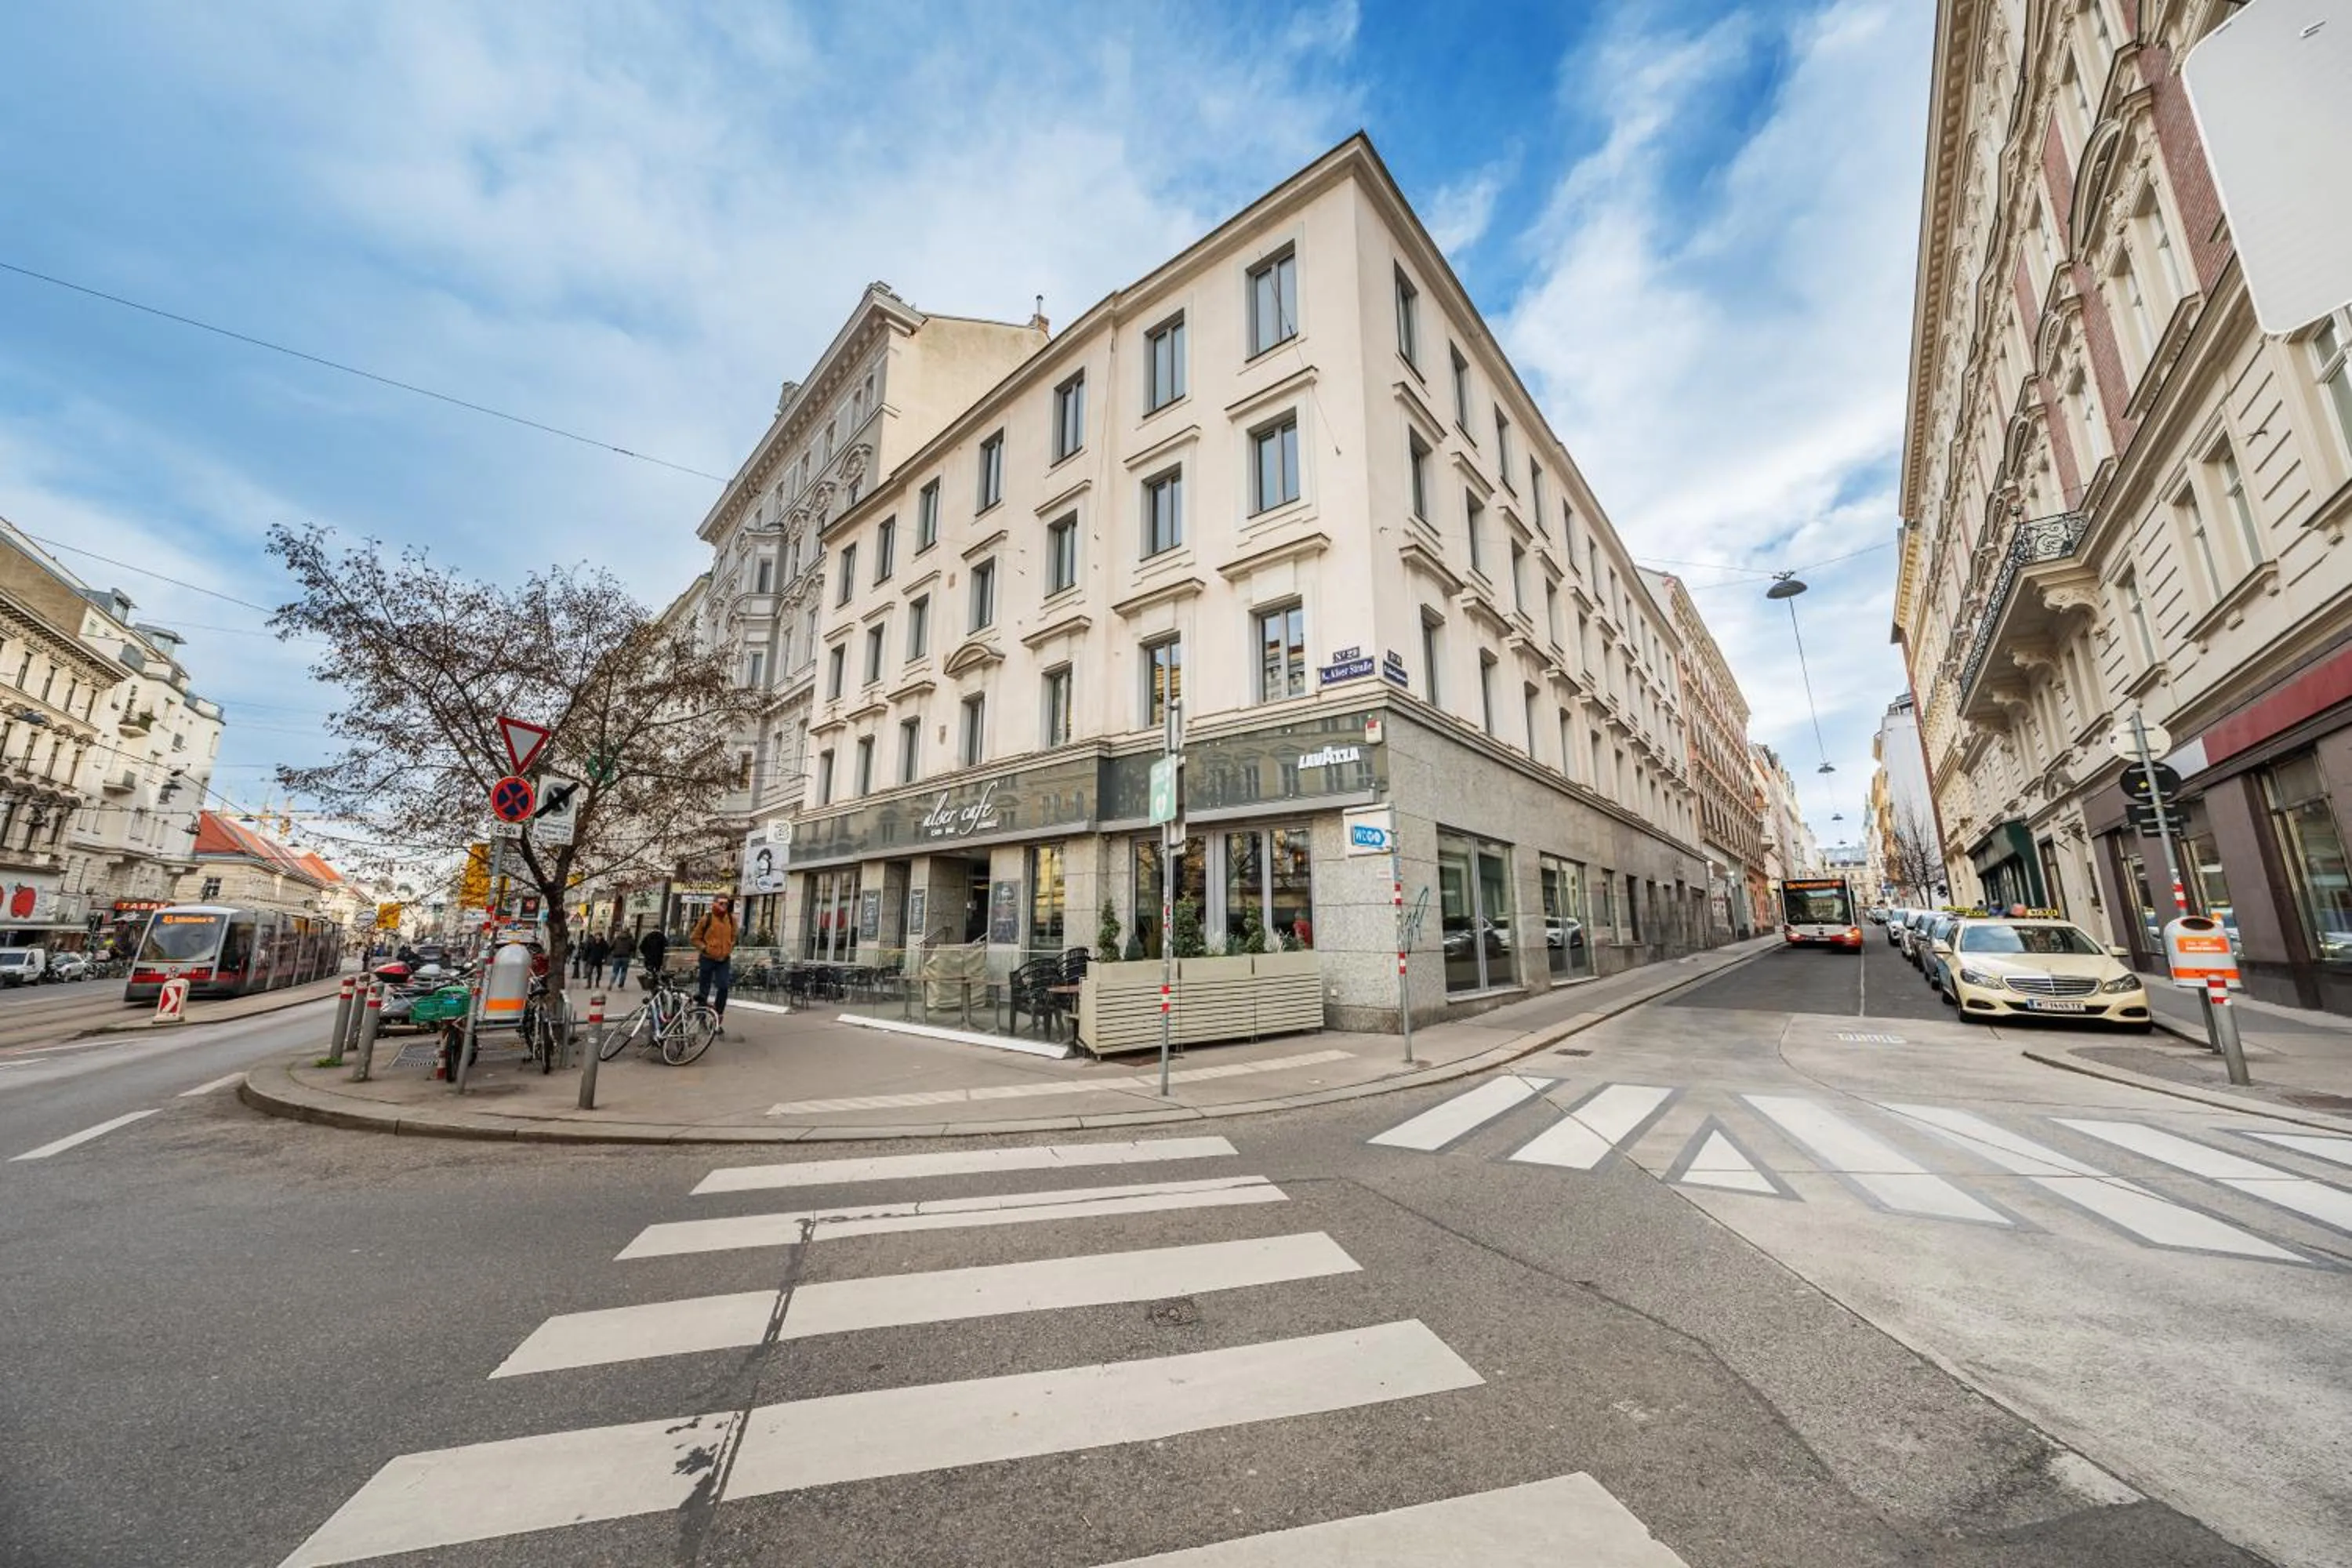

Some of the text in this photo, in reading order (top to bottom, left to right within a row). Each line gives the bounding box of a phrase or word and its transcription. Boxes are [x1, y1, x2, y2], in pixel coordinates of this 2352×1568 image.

[1330, 665, 1348, 677] Alser
[1298, 746, 1359, 769] LAVAZZA
[923, 781, 998, 836] alser cafe
